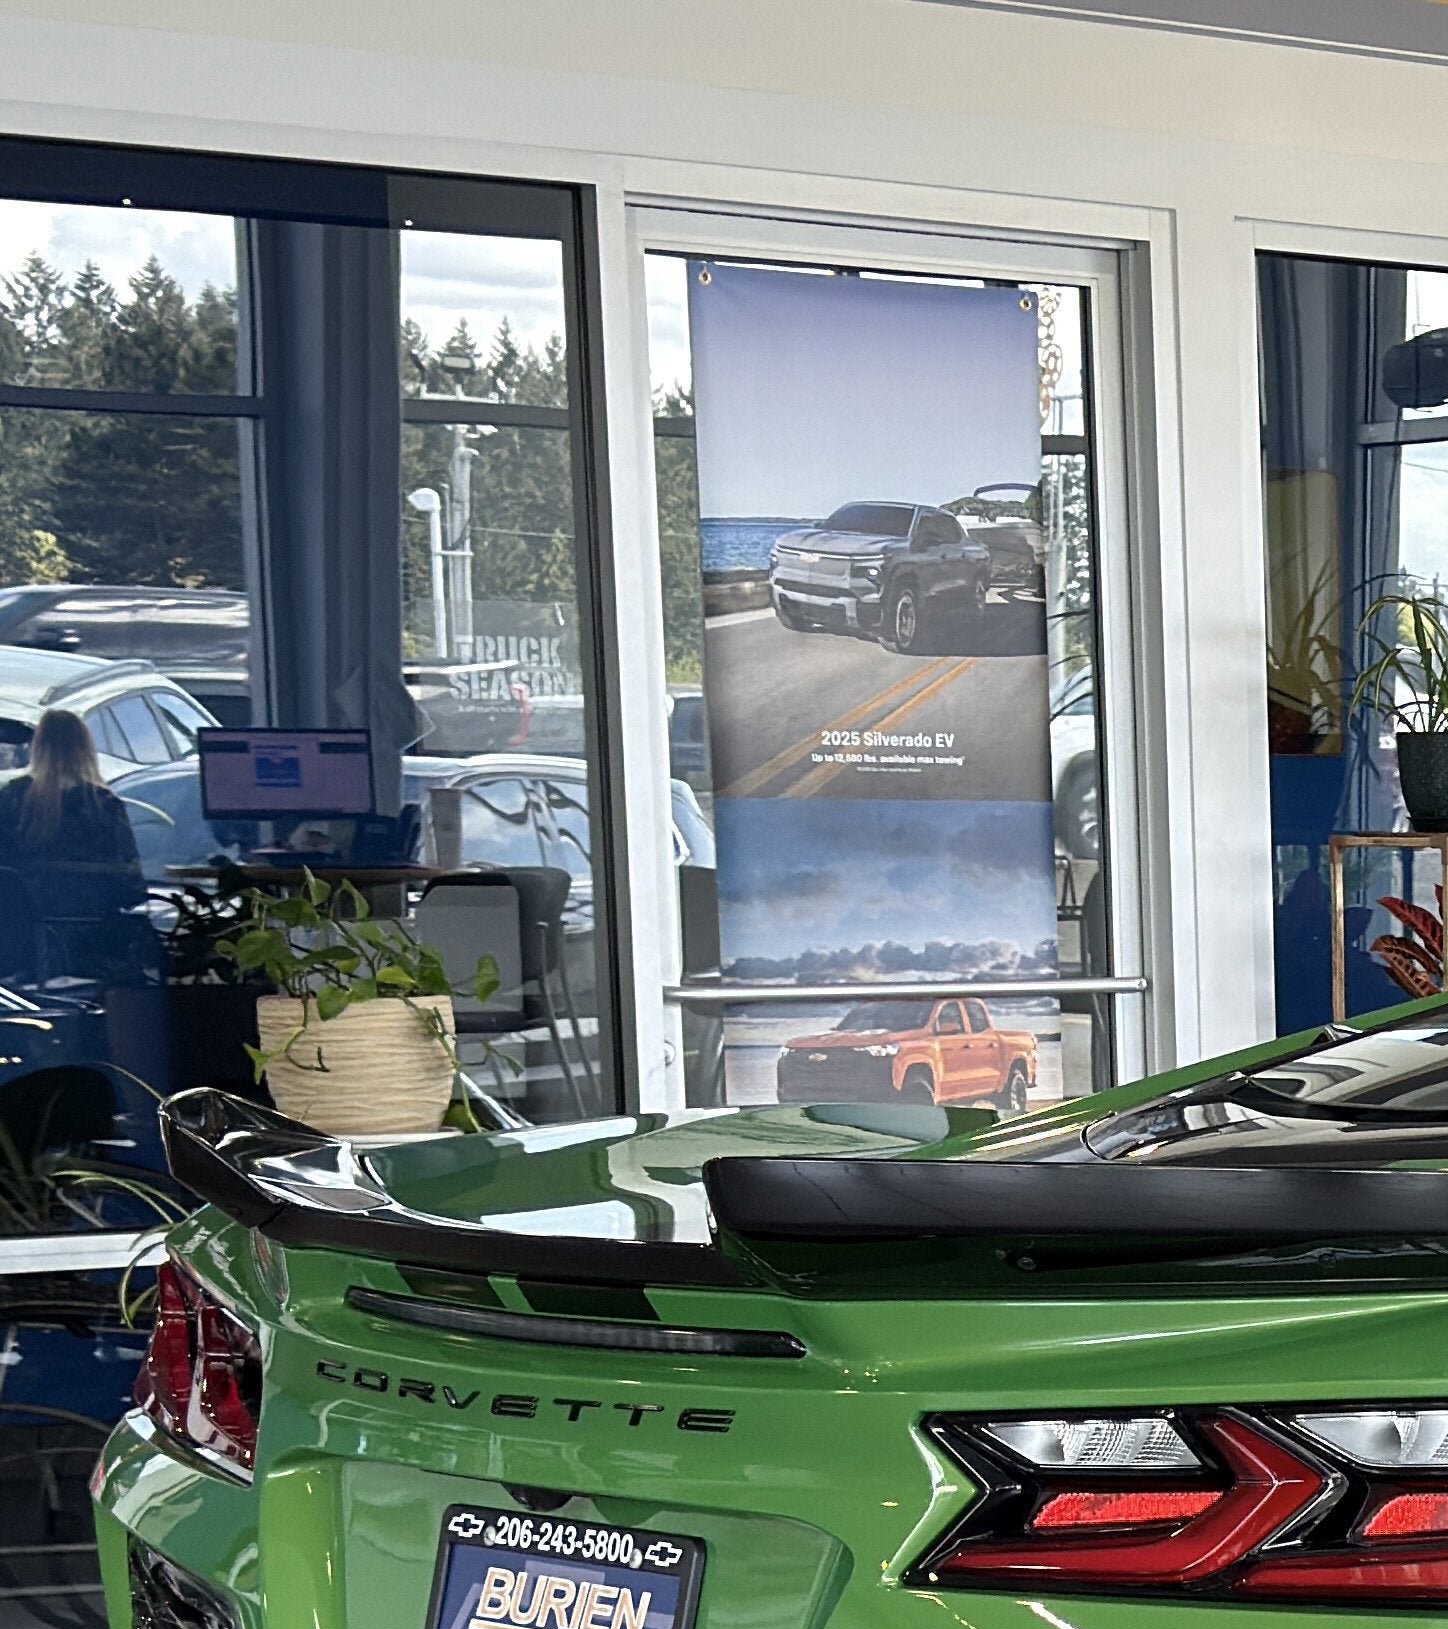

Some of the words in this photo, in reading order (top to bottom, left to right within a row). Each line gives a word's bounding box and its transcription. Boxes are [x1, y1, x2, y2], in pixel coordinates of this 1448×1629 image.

[821, 730, 861, 747] 2025
[863, 731, 933, 748] Silverado
[935, 732, 955, 748] EV
[316, 1359, 737, 1434] CORVETTE
[495, 1516, 633, 1564] 206-243-5800
